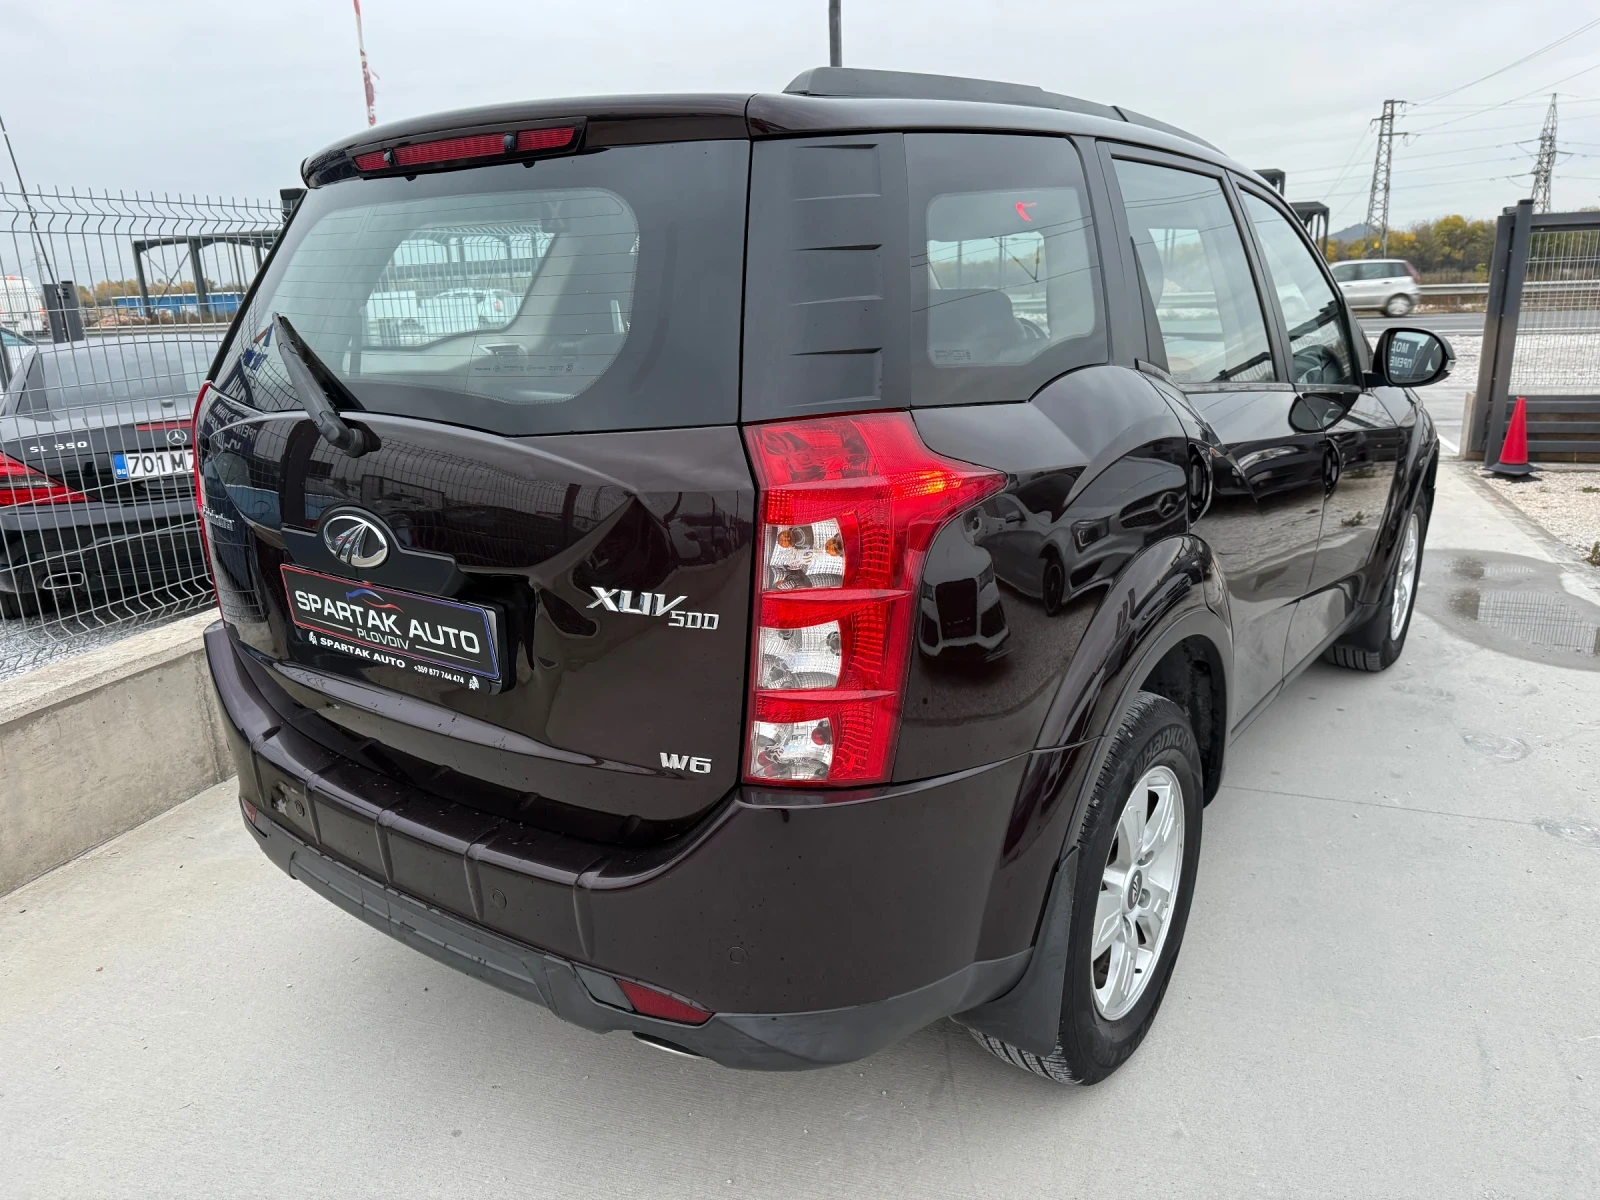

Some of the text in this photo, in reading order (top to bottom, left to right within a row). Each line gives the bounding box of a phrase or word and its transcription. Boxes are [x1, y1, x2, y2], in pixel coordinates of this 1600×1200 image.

[29, 445, 48, 453] SL
[295, 590, 480, 654] SPARTAK AUTO
[667, 610, 720, 630] 500
[357, 628, 410, 650] PLOVDIV
[320, 637, 371, 659] SPARTAK
[373, 651, 406, 668] AUTO
[413, 664, 428, 674] +359
[659, 751, 712, 774] W6
